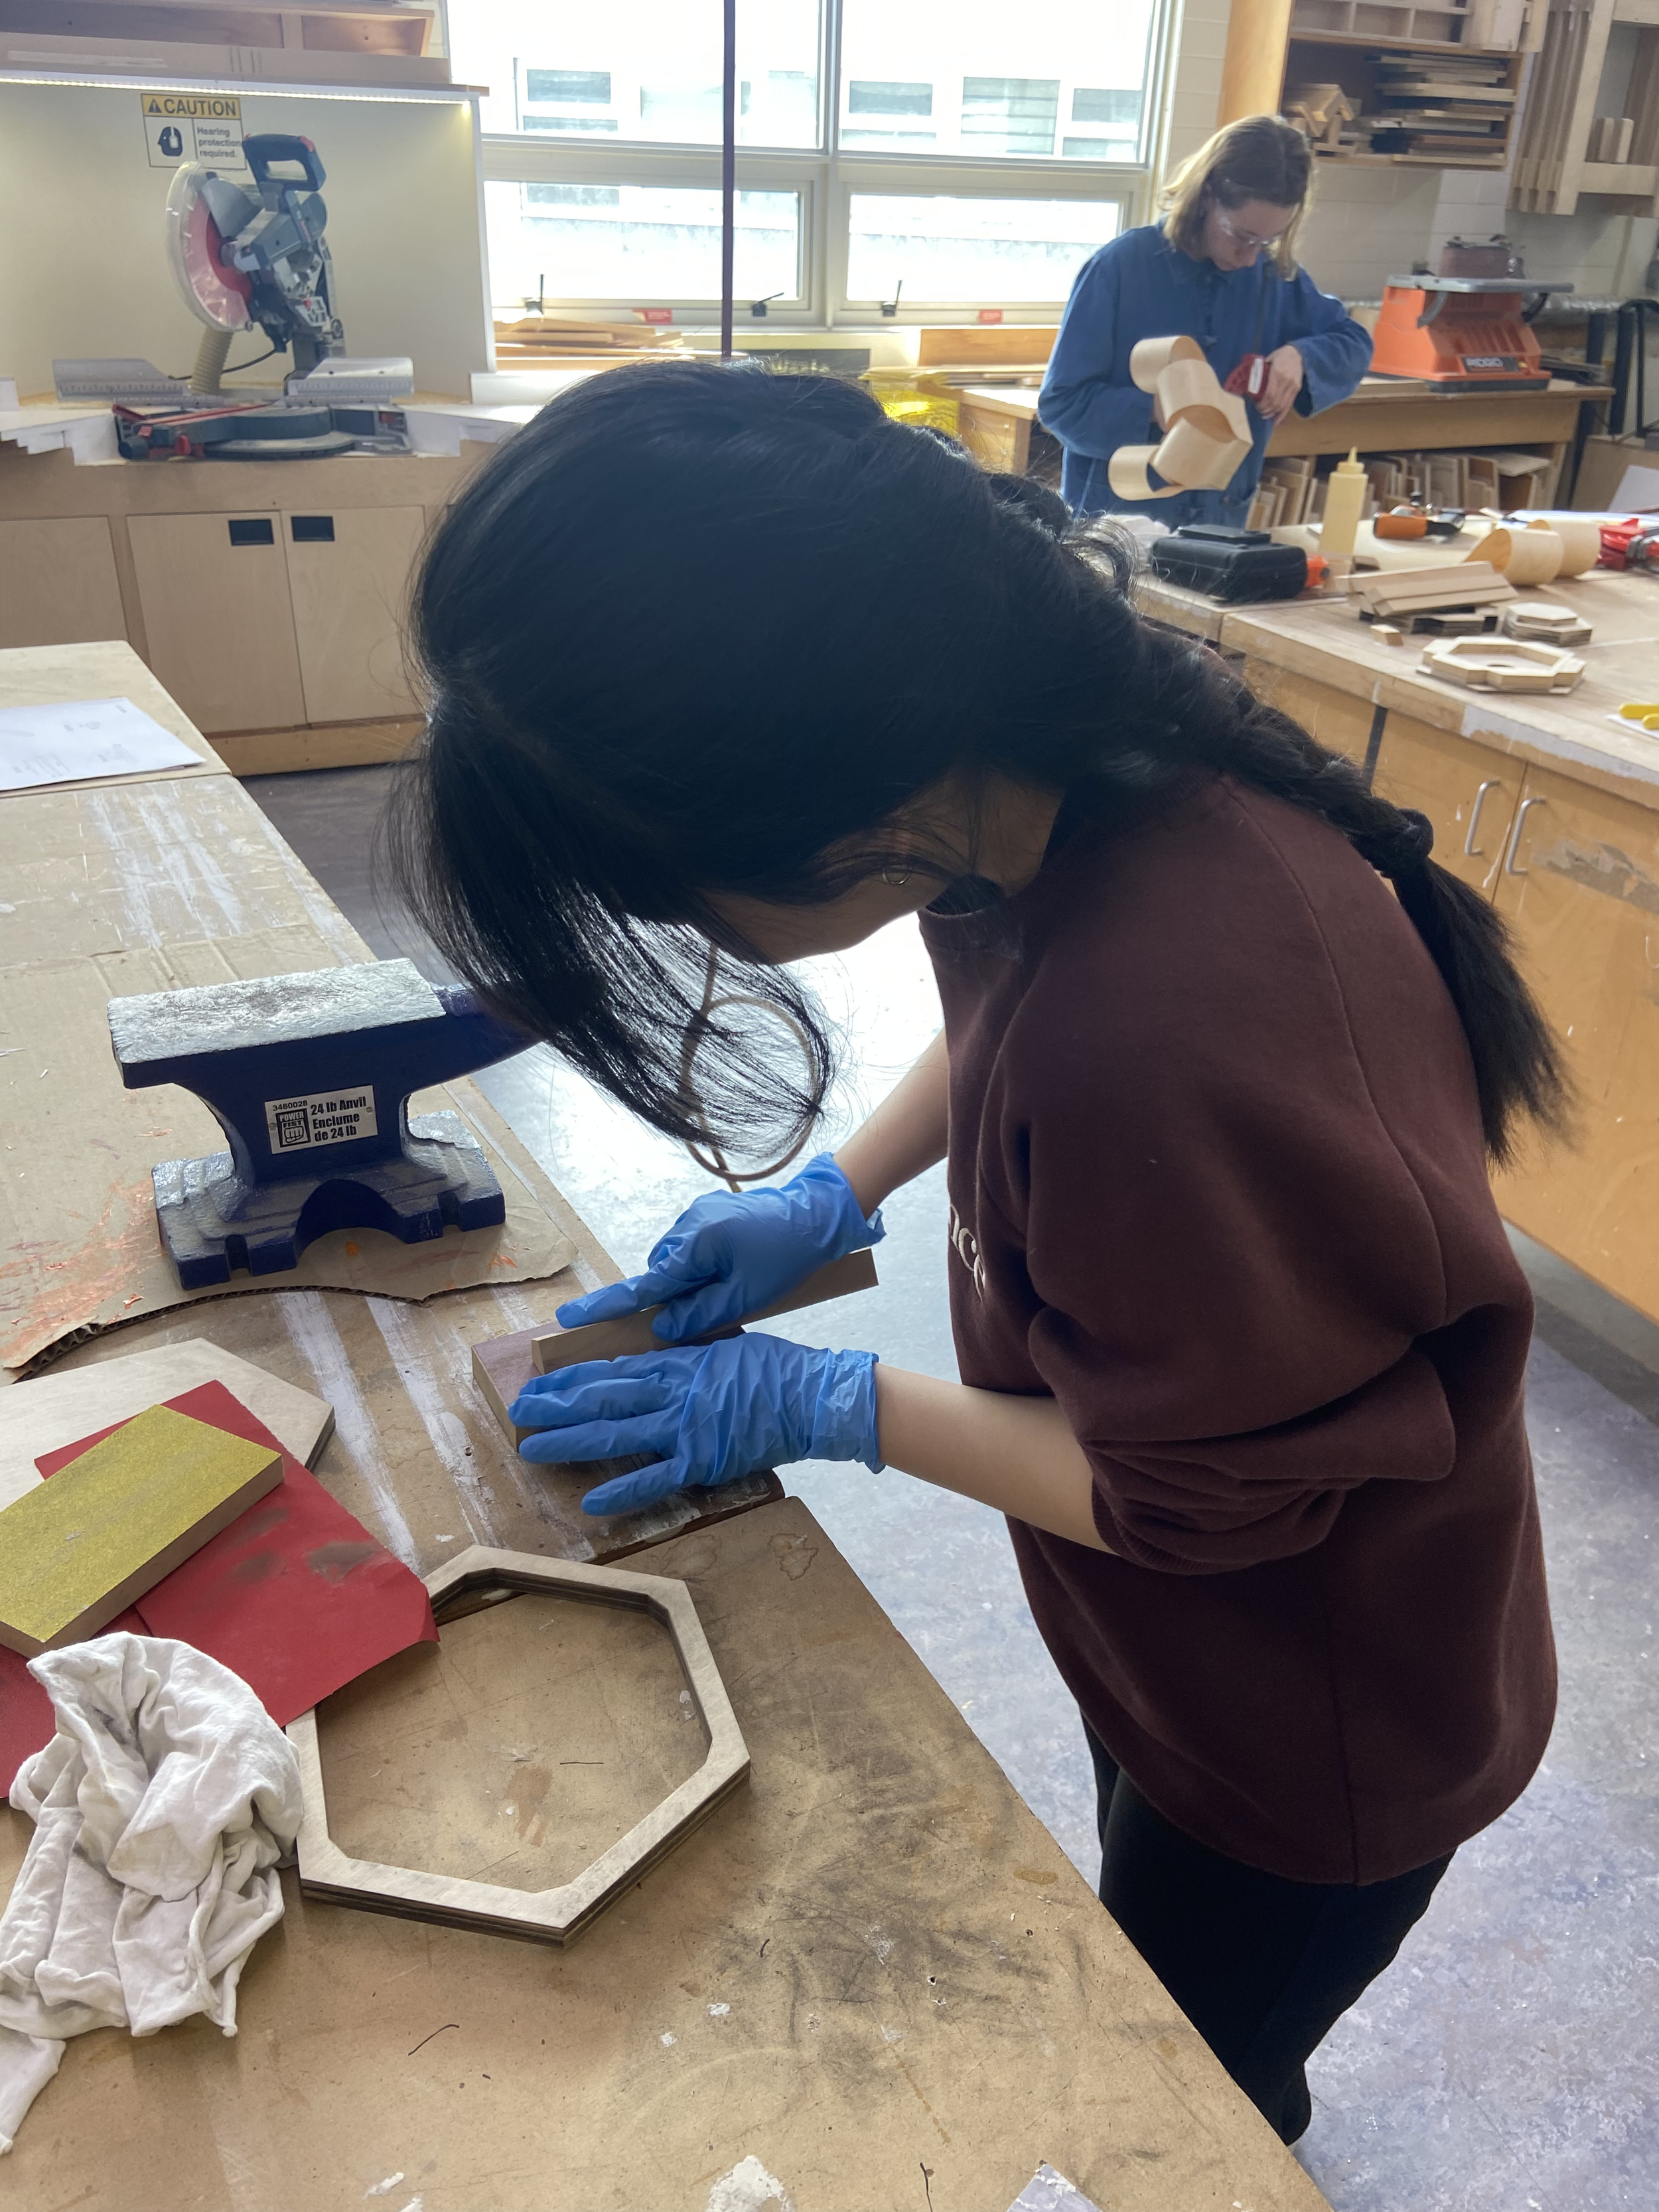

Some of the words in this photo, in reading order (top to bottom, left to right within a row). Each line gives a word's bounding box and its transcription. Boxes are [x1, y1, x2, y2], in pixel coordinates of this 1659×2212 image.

[164, 99, 236, 116] CAUTION
[197, 127, 230, 137] Hearing
[198, 139, 242, 147] protection
[200, 149, 238, 159] required.
[273, 1100, 308, 1112] 3460028
[311, 1104, 324, 1116] 24
[326, 1102, 337, 1113] lb
[339, 1096, 366, 1110] Anvil
[279, 1111, 304, 1122] POWER
[313, 1113, 360, 1130] Enclume
[315, 1131, 328, 1142] de
[330, 1128, 344, 1139] 24
[346, 1125, 357, 1136] lb
